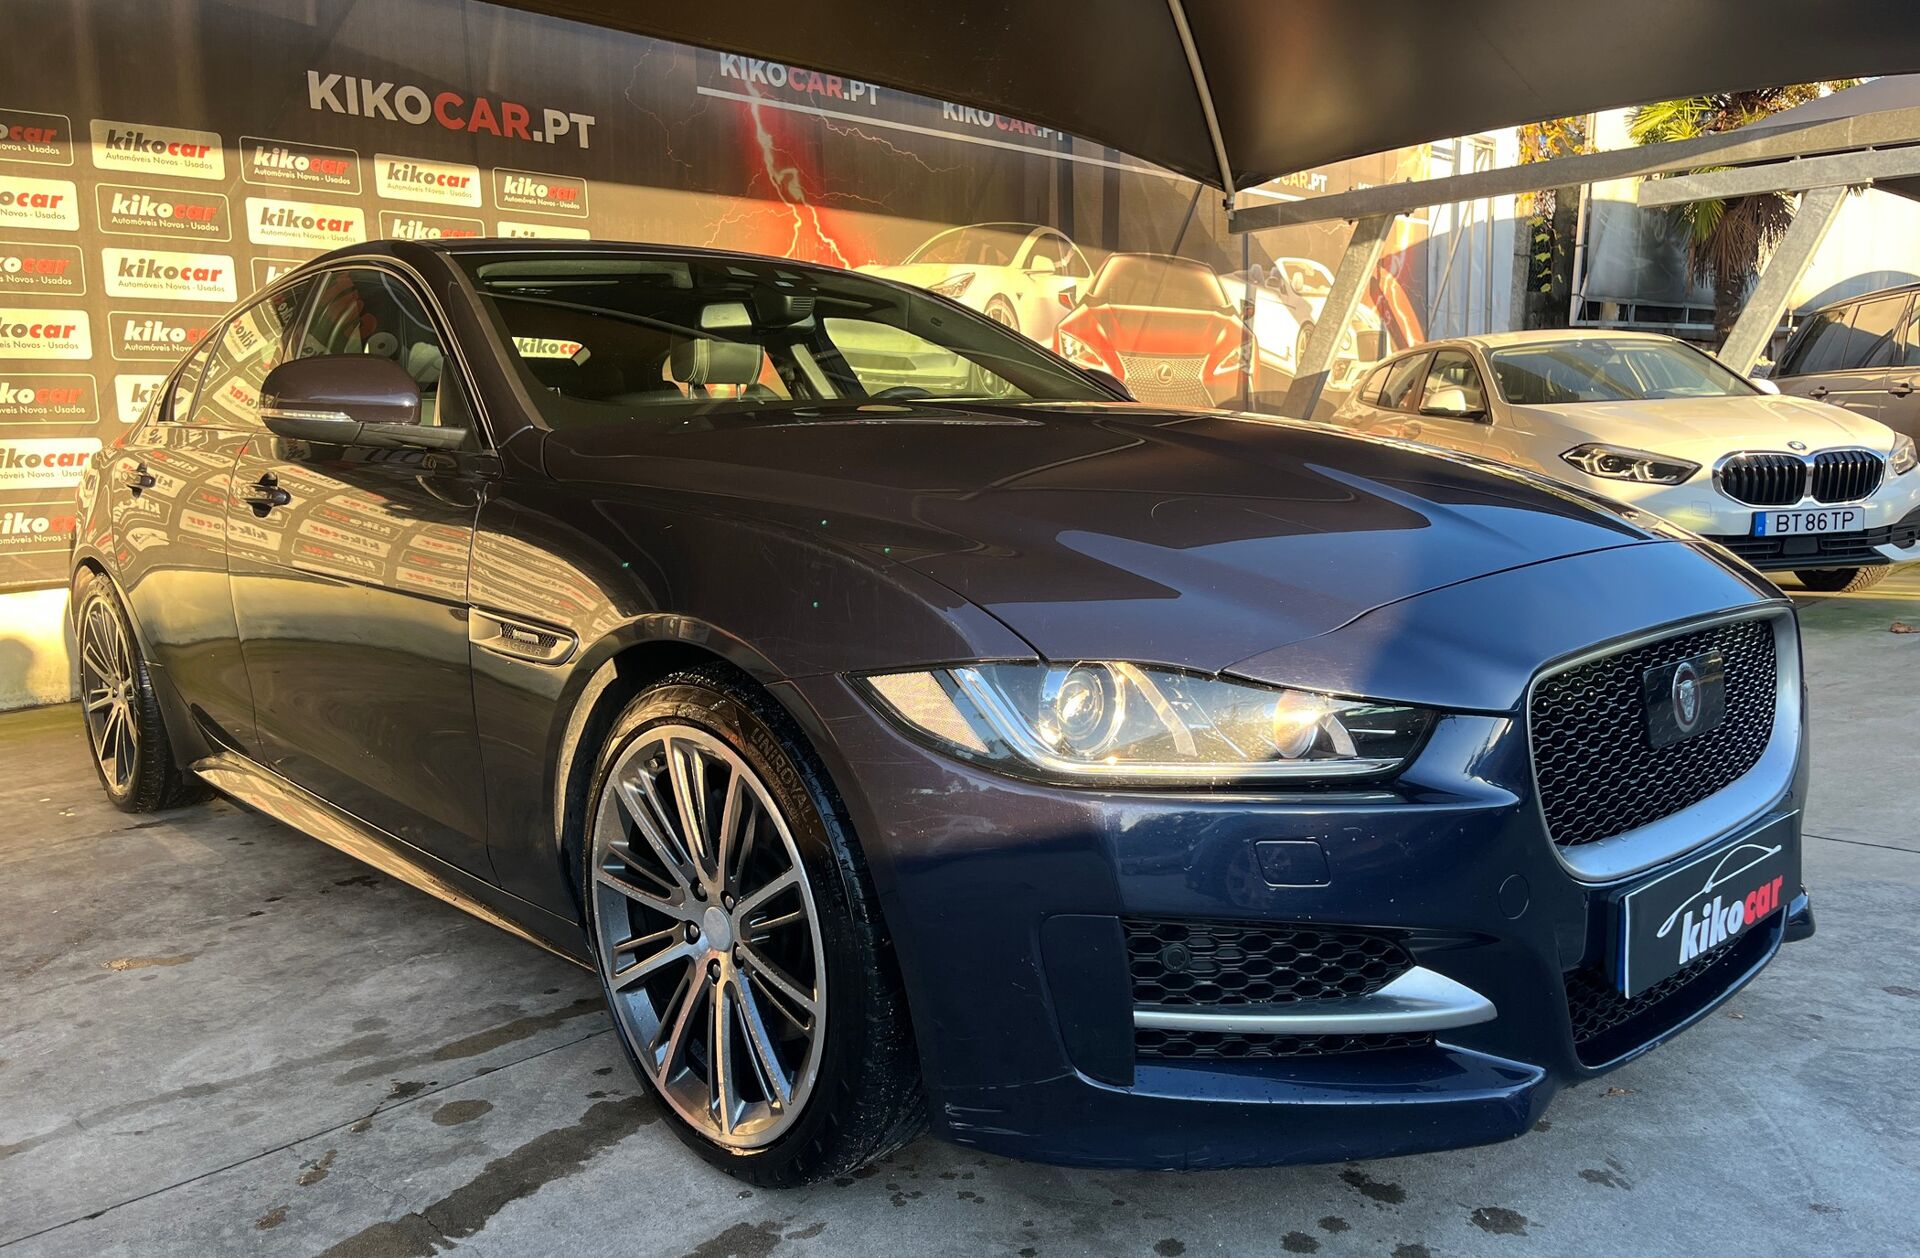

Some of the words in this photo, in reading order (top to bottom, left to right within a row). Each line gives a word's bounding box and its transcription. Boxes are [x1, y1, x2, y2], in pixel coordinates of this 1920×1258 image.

[720, 52, 880, 106] KIKOCAR.PT
[307, 70, 595, 149] KIKOCAR.PT
[28, 144, 60, 155] Usados
[105, 129, 211, 158] kikocar
[105, 152, 151, 164] Automóveis
[153, 156, 179, 166] Novos
[184, 159, 213, 170] Usados
[254, 146, 352, 175] kikocar
[254, 167, 296, 179] Automóveis
[297, 171, 320, 182] Novos
[325, 175, 351, 185] Usados
[387, 162, 471, 188] kikocar
[450, 189, 472, 198] Usados
[504, 175, 579, 200] kikocar
[111, 193, 217, 222] kikocar
[537, 198, 556, 207] Novos
[559, 201, 580, 210] Usados
[0, 209, 27, 217] Novos
[35, 211, 66, 220] Usados
[260, 207, 354, 233] kikocar
[111, 215, 157, 228] Automóveis
[159, 218, 184, 230] Novos
[190, 222, 219, 233] Usados
[260, 228, 301, 238] Automóveis
[303, 232, 325, 241] Novos
[331, 234, 356, 243] Usados
[118, 257, 222, 282] kikocar
[6, 274, 34, 283] Novos
[41, 276, 73, 286] Usados
[118, 280, 163, 289] Automóveis
[165, 283, 190, 291] Novos
[197, 283, 225, 293] Usados
[13, 341, 40, 349] Novos
[48, 341, 79, 350] Usados
[125, 343, 170, 352] Automóveis
[20, 406, 47, 414] Novos
[54, 405, 86, 414] Usados
[27, 471, 55, 479] Novos
[1776, 513, 1803, 533] BT
[1805, 513, 1828, 532] 86
[1831, 511, 1855, 531] TP
[34, 534, 62, 543] Novos
[1678, 875, 1783, 965] kikocar
